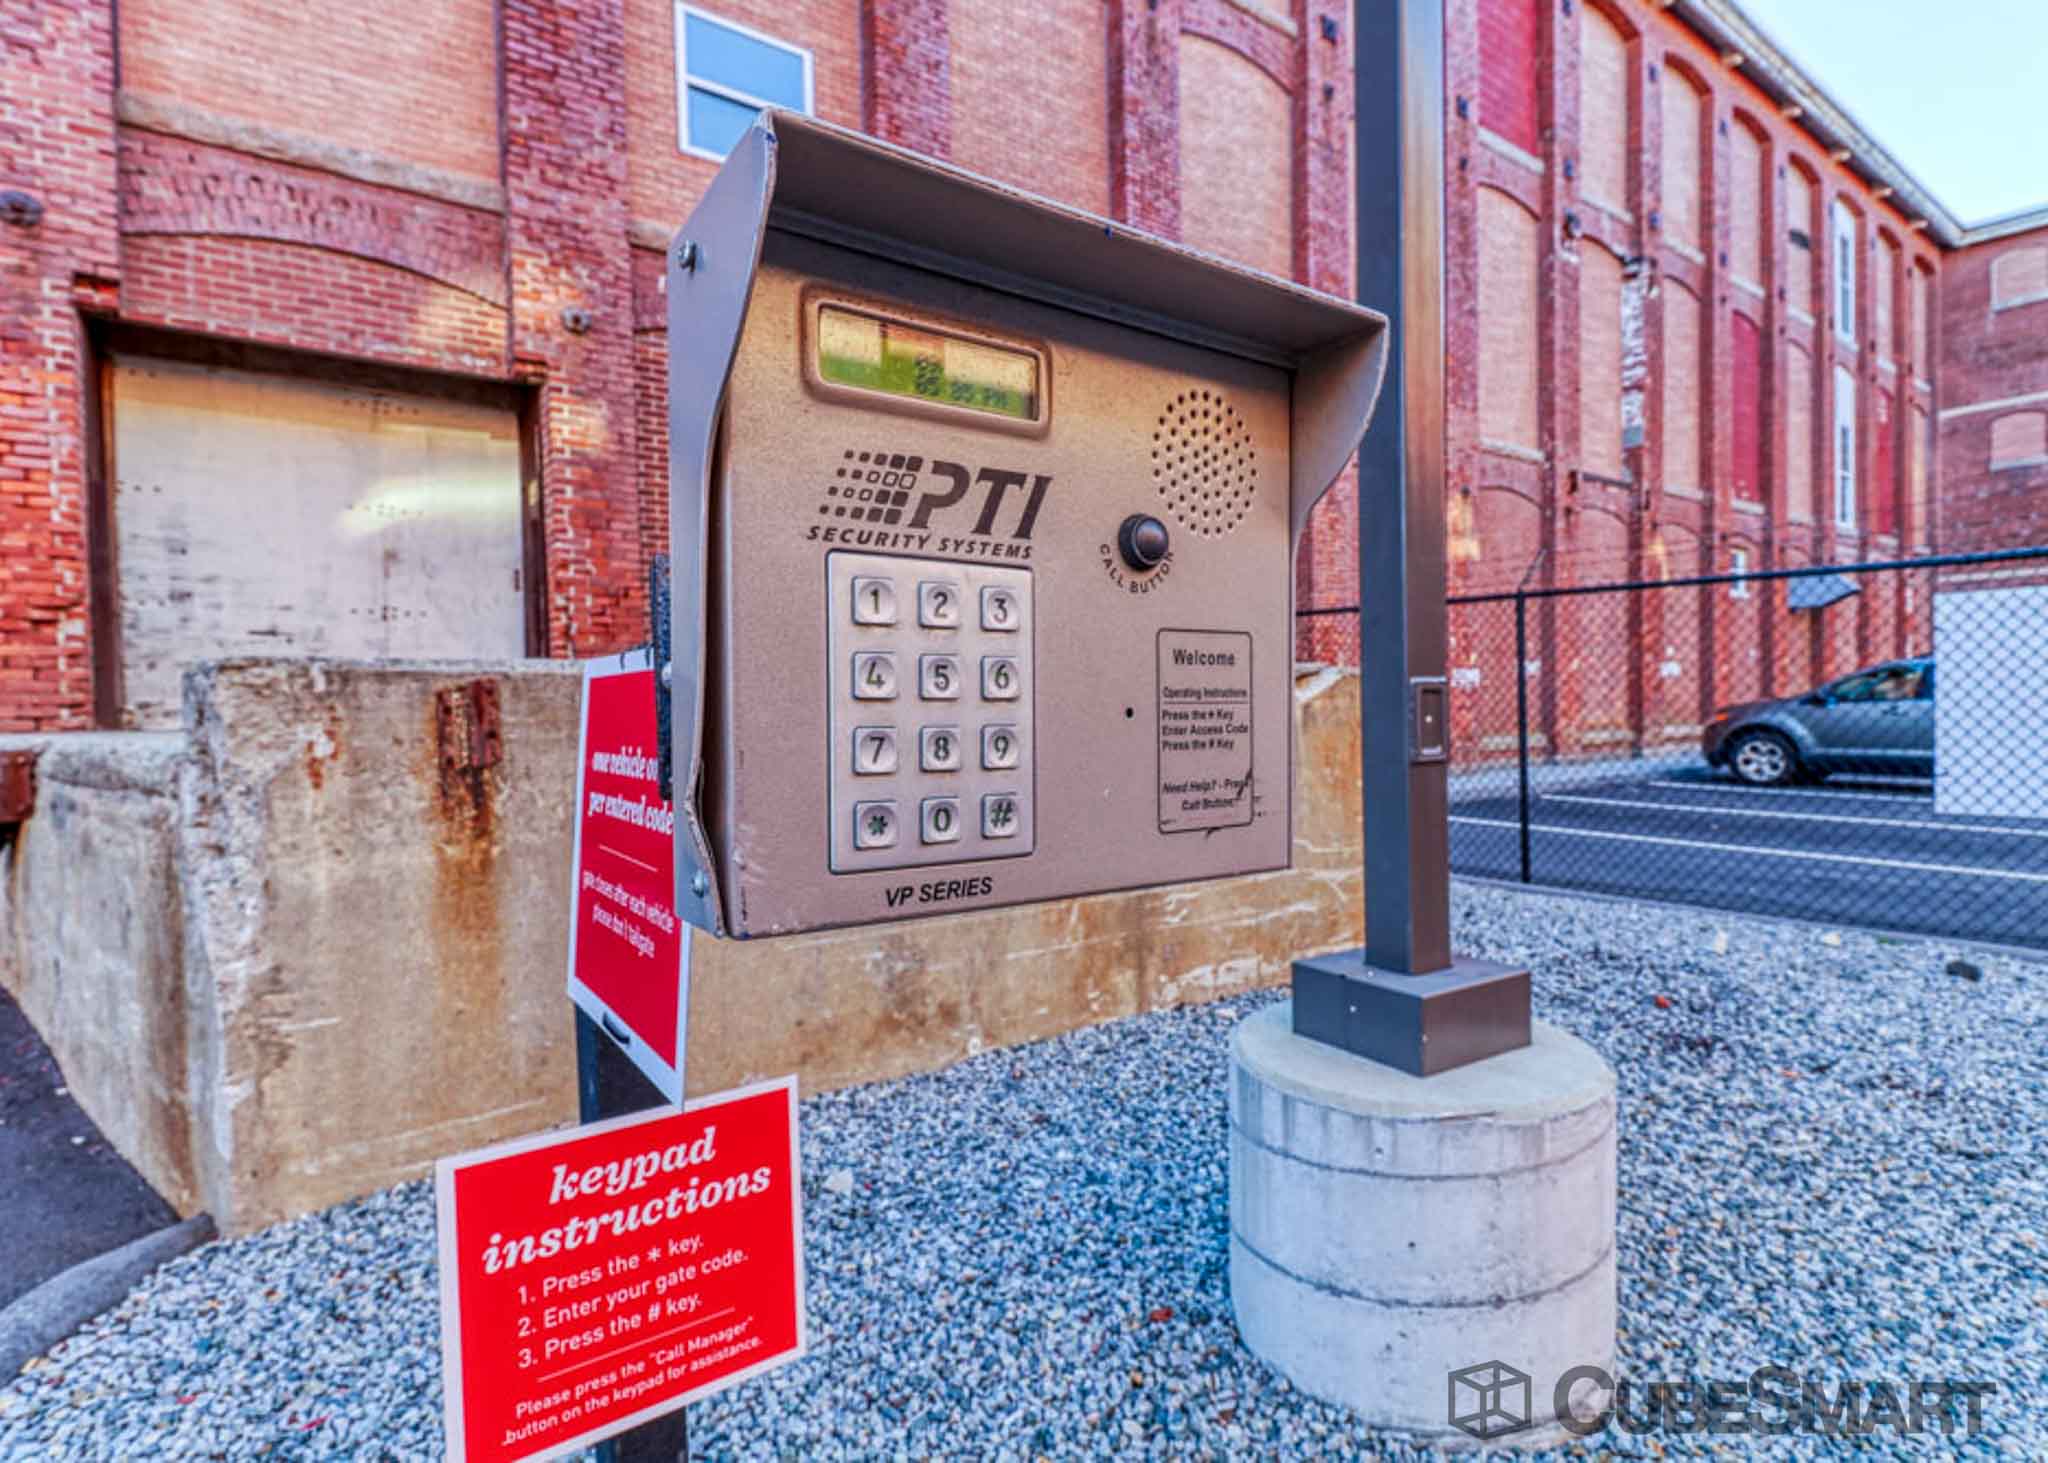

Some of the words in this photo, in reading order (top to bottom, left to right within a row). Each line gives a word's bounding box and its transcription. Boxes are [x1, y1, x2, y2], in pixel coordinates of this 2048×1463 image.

[907, 459, 1053, 540] PTI
[806, 525, 931, 550] SECURITY
[938, 537, 1033, 559] SYSTEMS
[1100, 544, 1123, 588] CALL
[1129, 552, 1174, 593] BUTTON
[870, 587, 881, 615] 1
[933, 591, 948, 619] 2
[993, 597, 1008, 625] 3
[1172, 649, 1236, 666] Welcome
[866, 661, 885, 690] 4
[934, 664, 949, 692] 5
[994, 662, 1010, 690] 6
[1162, 686, 1202, 700] Operating
[1162, 709, 1190, 720] Press
[1191, 709, 1206, 720] the
[1216, 709, 1234, 722] Key
[1162, 725, 1188, 736] Enter
[1190, 724, 1223, 736] Access
[1225, 723, 1249, 735] Code
[869, 736, 886, 764] 7
[934, 737, 950, 762] 8
[994, 735, 1010, 761] 9
[1162, 740, 1190, 751] Press
[1191, 740, 1206, 751] the
[1216, 738, 1235, 751] Key
[609, 745, 646, 780] vehicle
[1162, 782, 1188, 794] Need
[1181, 799, 1201, 811] Call
[588, 791, 605, 818] per
[605, 793, 647, 827] entered
[646, 800, 674, 836] code
[933, 807, 951, 832] 0
[990, 801, 1013, 827] #
[885, 886, 914, 908] VP
[918, 876, 993, 903] SERIES
[549, 1125, 717, 1206] keypad
[481, 1165, 771, 1275] instructions
[517, 1286, 536, 1306] 1.
[542, 1264, 604, 1298] Press
[607, 1251, 641, 1277] the
[668, 1234, 704, 1257] key.
[517, 1316, 537, 1338] 2.
[543, 1296, 601, 1330] Enter
[605, 1278, 651, 1312] your
[655, 1263, 697, 1295] gate
[701, 1248, 750, 1276] code.
[517, 1347, 538, 1369] 3.
[544, 1325, 605, 1360] Press
[609, 1311, 642, 1337] the
[647, 1302, 662, 1323] #
[666, 1291, 703, 1317] key.
[515, 1386, 572, 1420] Please
[574, 1371, 618, 1400] press
[620, 1359, 646, 1380] the
[649, 1341, 685, 1367] "Call
[687, 1316, 754, 1352] Manager"
[505, 1412, 560, 1445] button
[561, 1405, 582, 1423] on
[584, 1395, 611, 1414] the
[613, 1370, 665, 1403] keypad
[667, 1361, 688, 1382] for
[690, 1335, 764, 1373] assistance.
